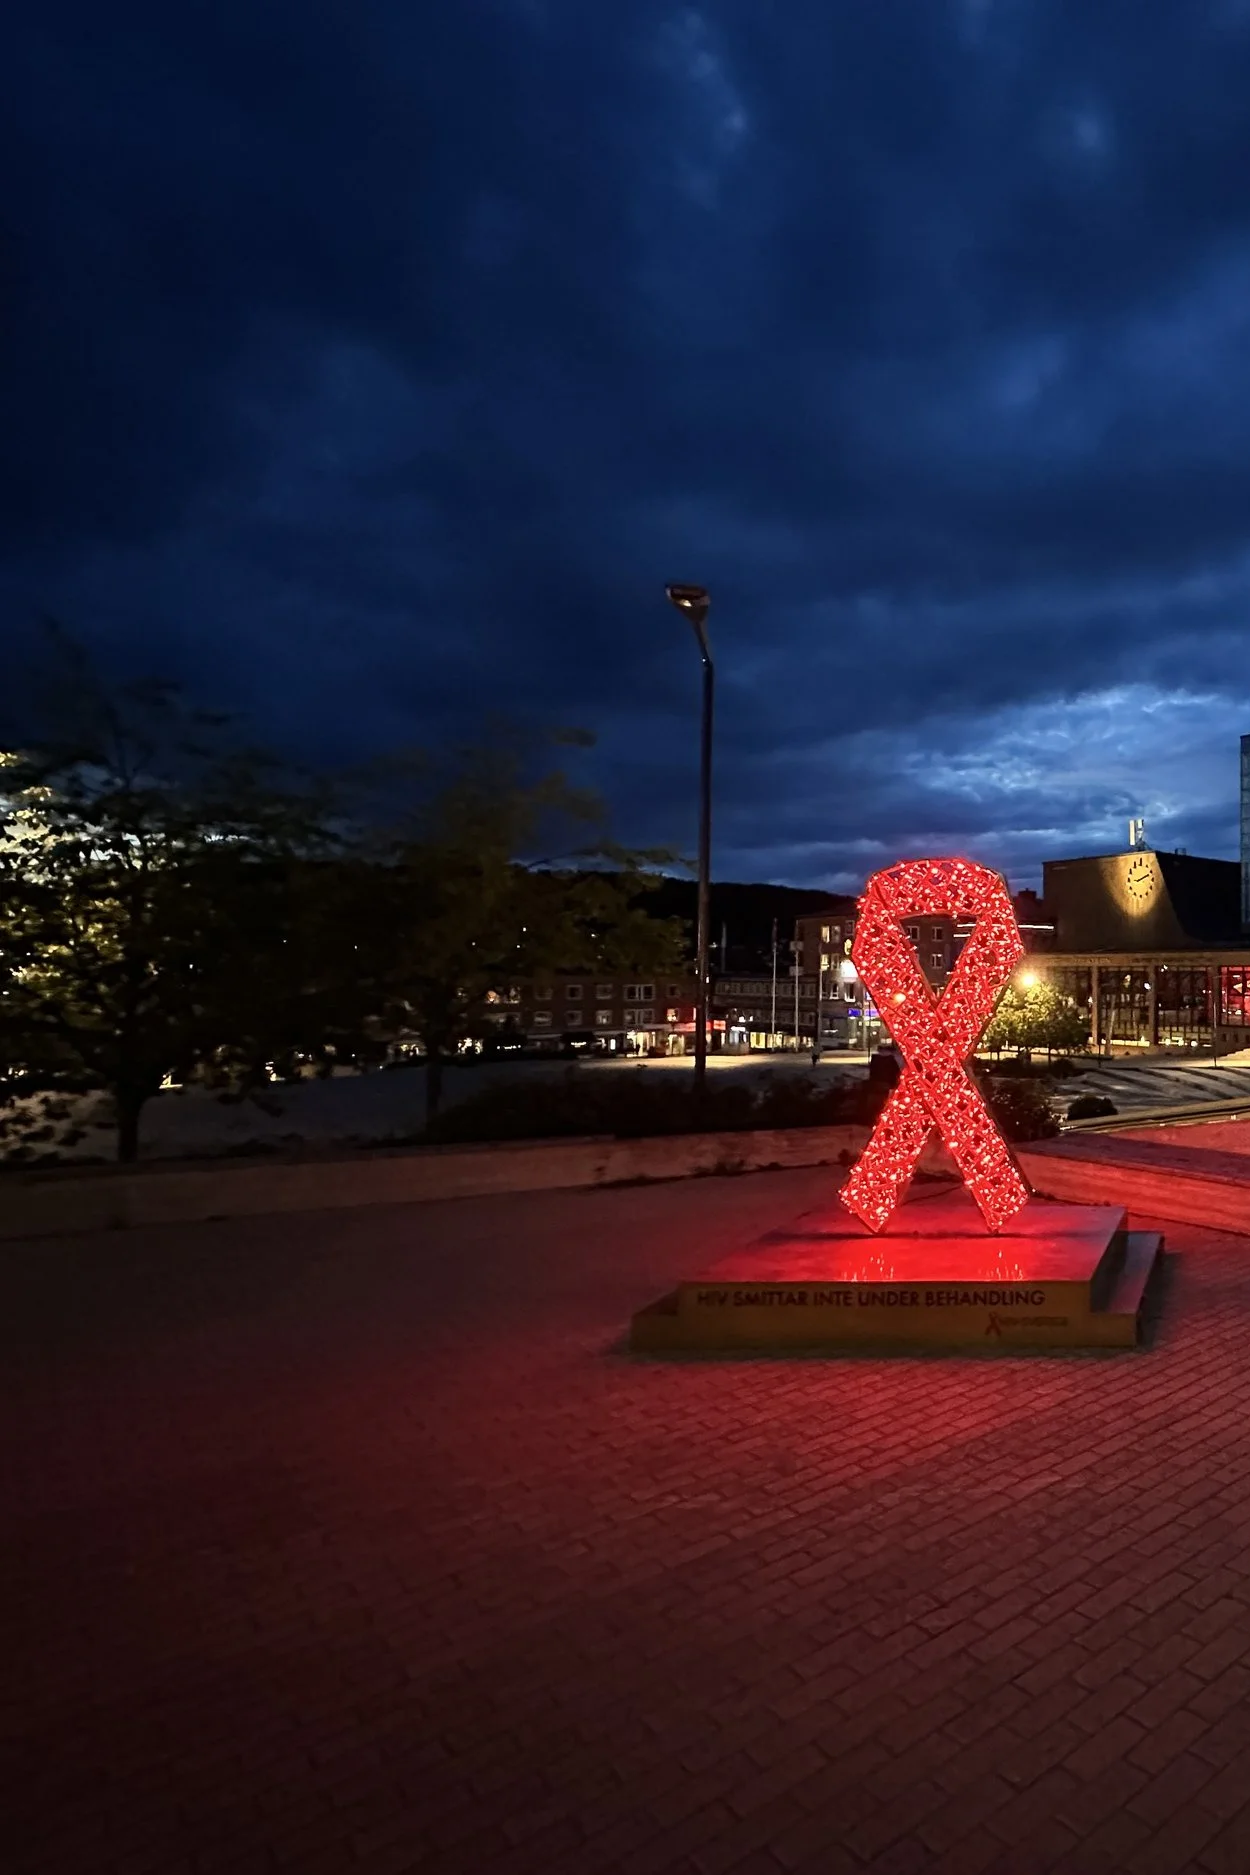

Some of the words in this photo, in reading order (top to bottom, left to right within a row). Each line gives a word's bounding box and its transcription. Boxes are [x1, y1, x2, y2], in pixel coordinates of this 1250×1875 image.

[697, 1290, 728, 1306] HIV
[732, 1290, 809, 1306] SMITTAR
[813, 1290, 854, 1306] INTE
[858, 1290, 919, 1306] UNDER
[924, 1289, 1046, 1306] BEHANDLING
